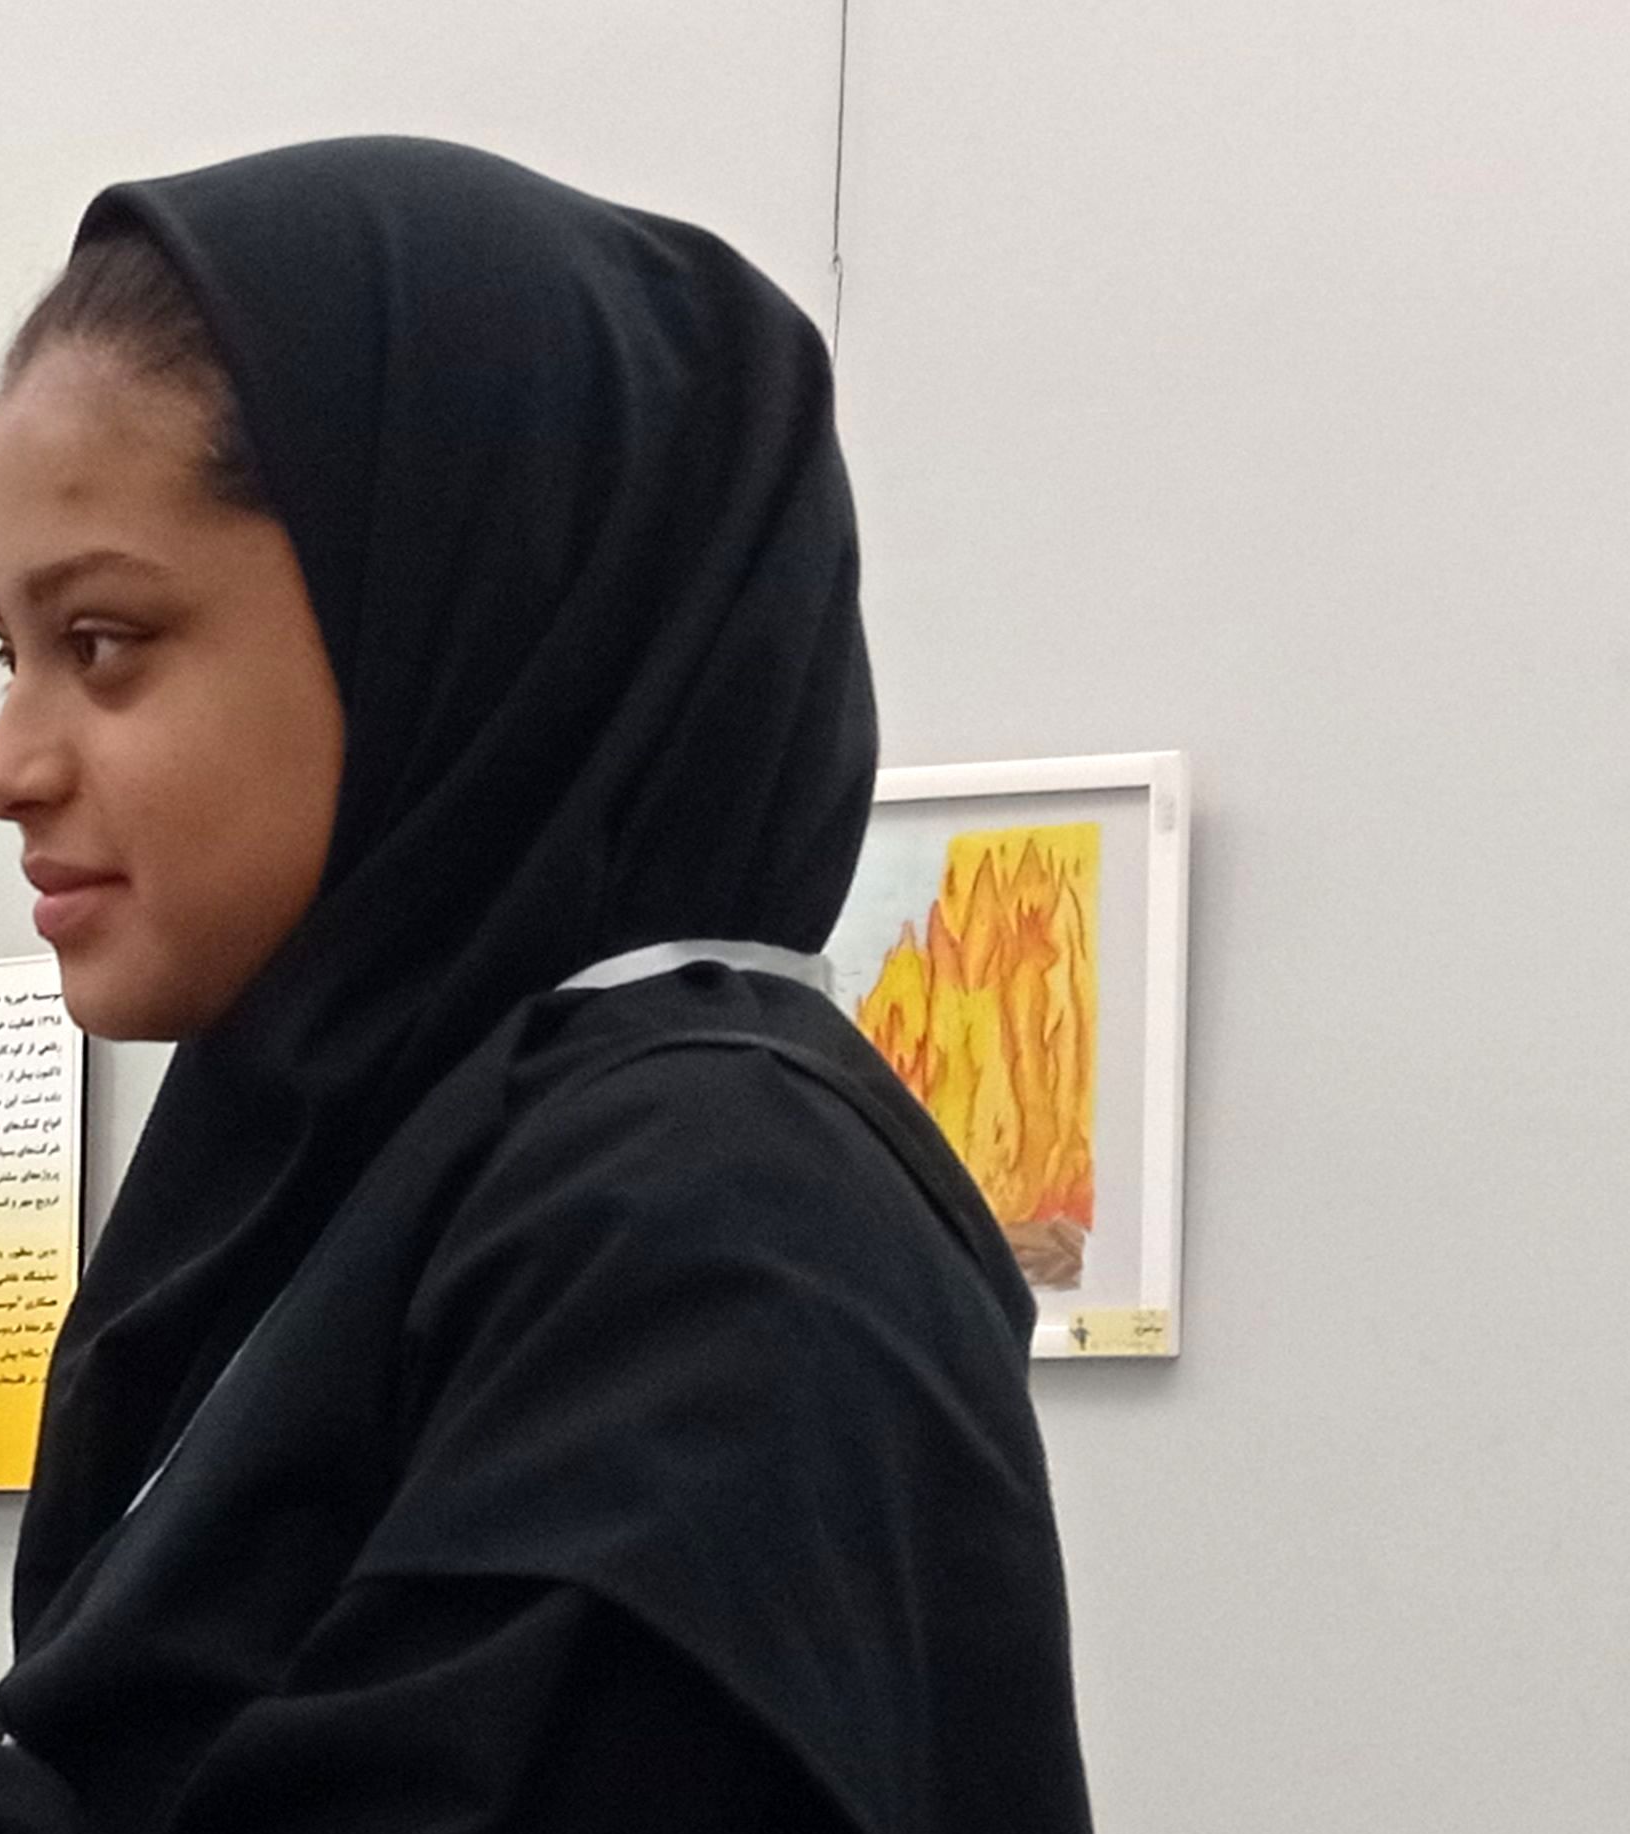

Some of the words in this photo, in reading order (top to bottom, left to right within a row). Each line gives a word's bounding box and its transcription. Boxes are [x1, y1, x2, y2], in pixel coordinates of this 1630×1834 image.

[3, 994, 28, 1005] خیریه
[32, 993, 62, 1001] وسسه
[15, 1069, 33, 1083] بیش
[3, 1094, 18, 1109] این
